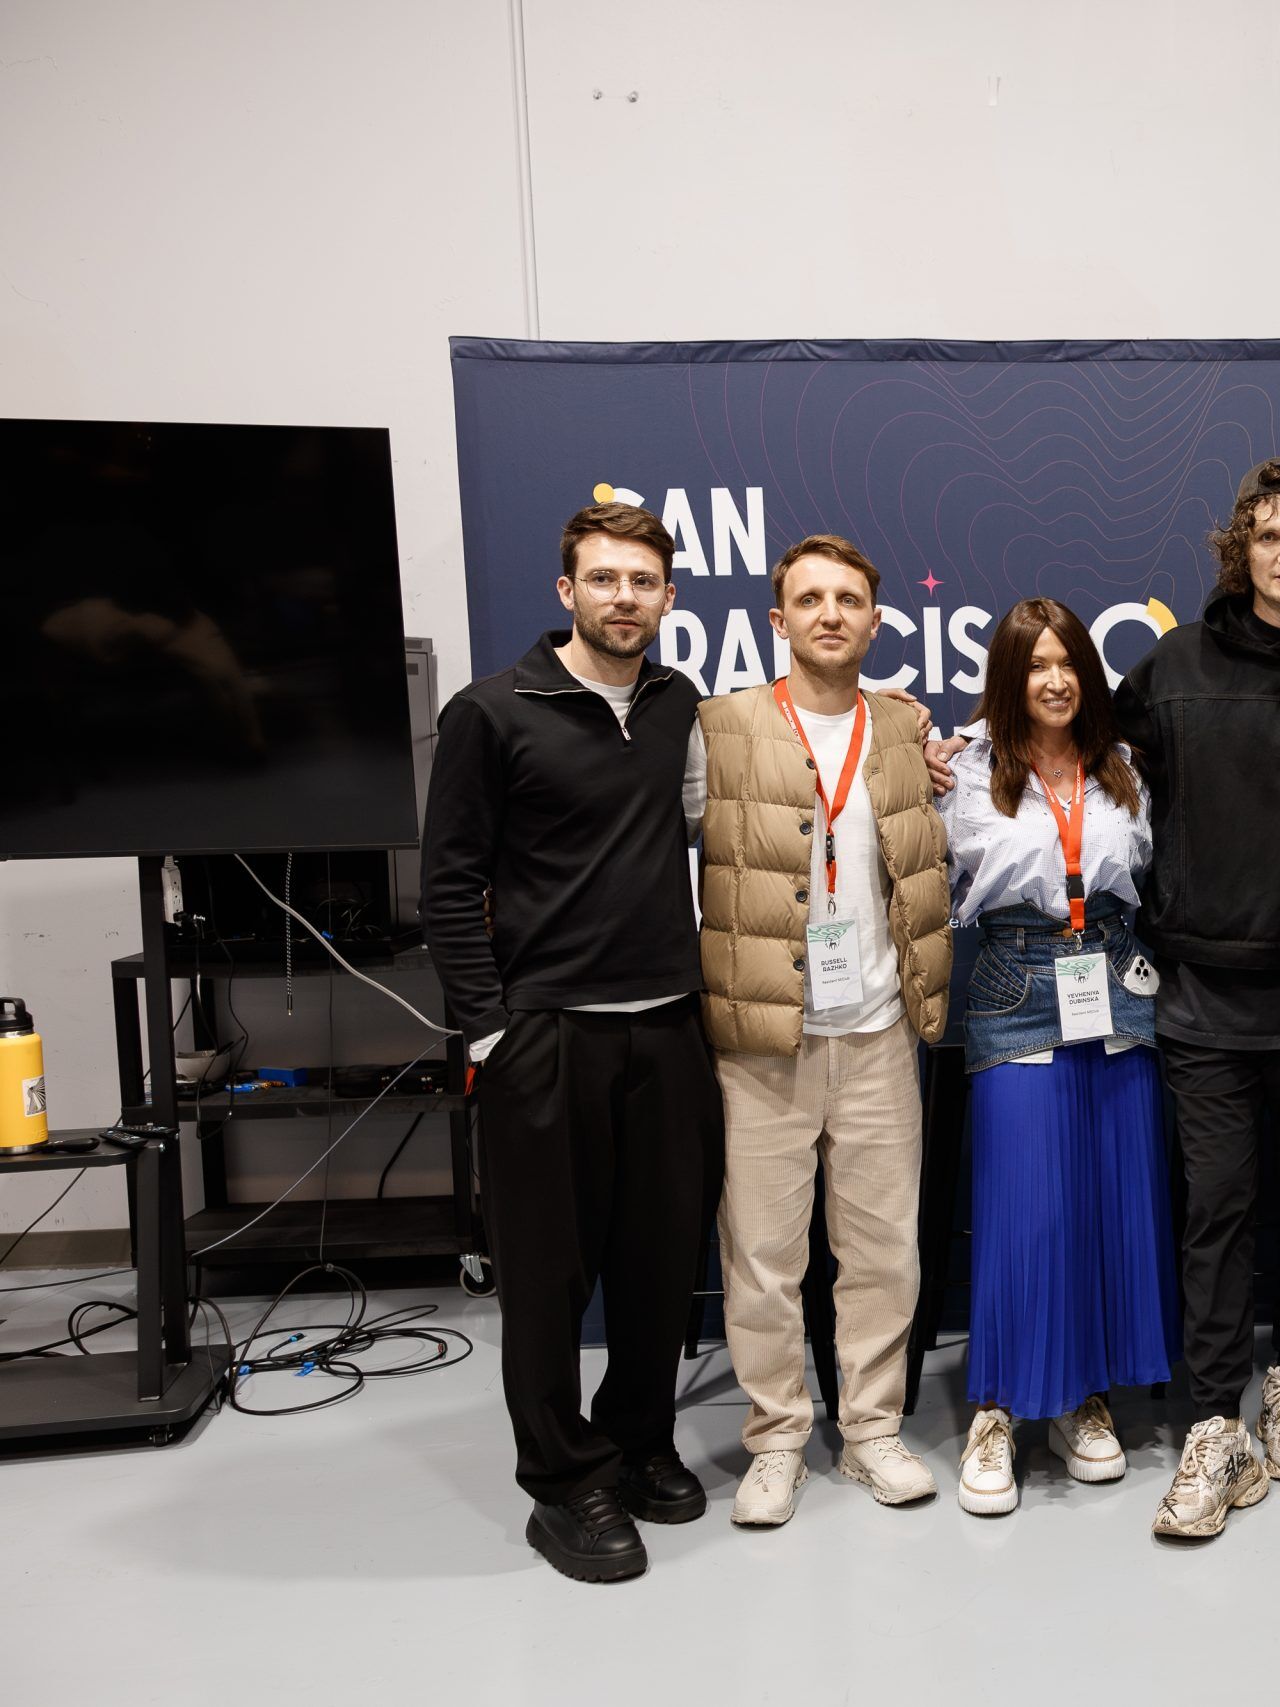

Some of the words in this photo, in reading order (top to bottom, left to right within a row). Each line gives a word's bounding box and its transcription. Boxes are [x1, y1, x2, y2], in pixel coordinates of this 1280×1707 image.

[593, 483, 767, 576] AN
[821, 958, 848, 966] RUSSELL
[822, 964, 848, 972] RAZHKO
[1067, 991, 1100, 999] YEVHENIYA
[1160, 1516, 1171, 1527] 44
